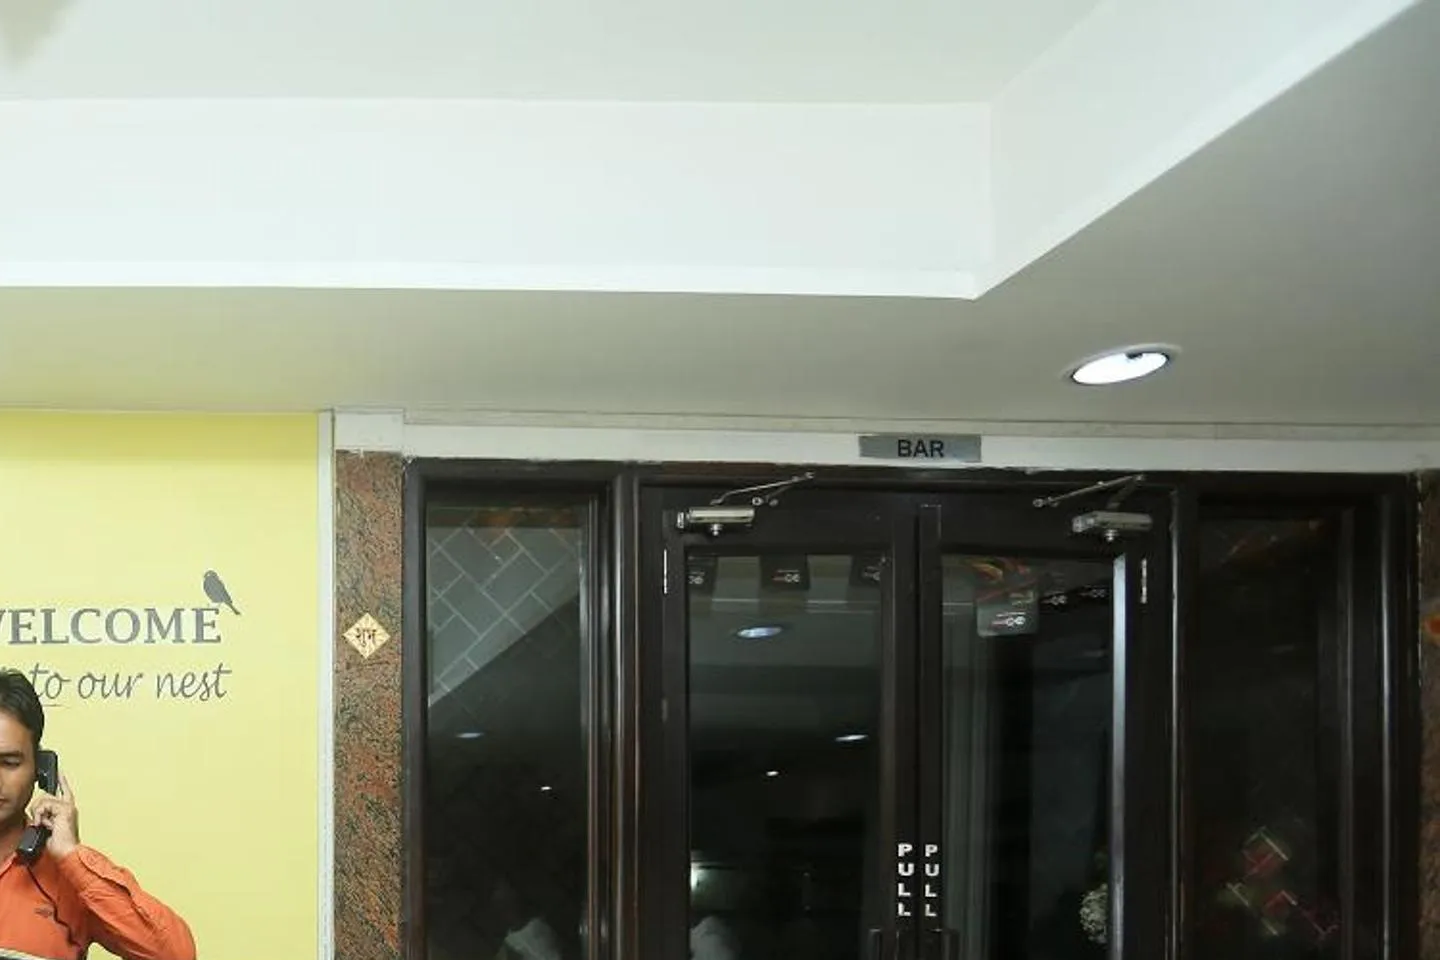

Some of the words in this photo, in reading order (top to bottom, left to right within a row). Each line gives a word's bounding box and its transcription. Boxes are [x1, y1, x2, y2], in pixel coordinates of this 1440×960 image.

[897, 439, 944, 458] BAR
[30, 662, 71, 699] to
[77, 671, 144, 699] our
[156, 662, 233, 701] nest
[898, 843, 915, 917] PULL
[925, 844, 940, 917] PULL
